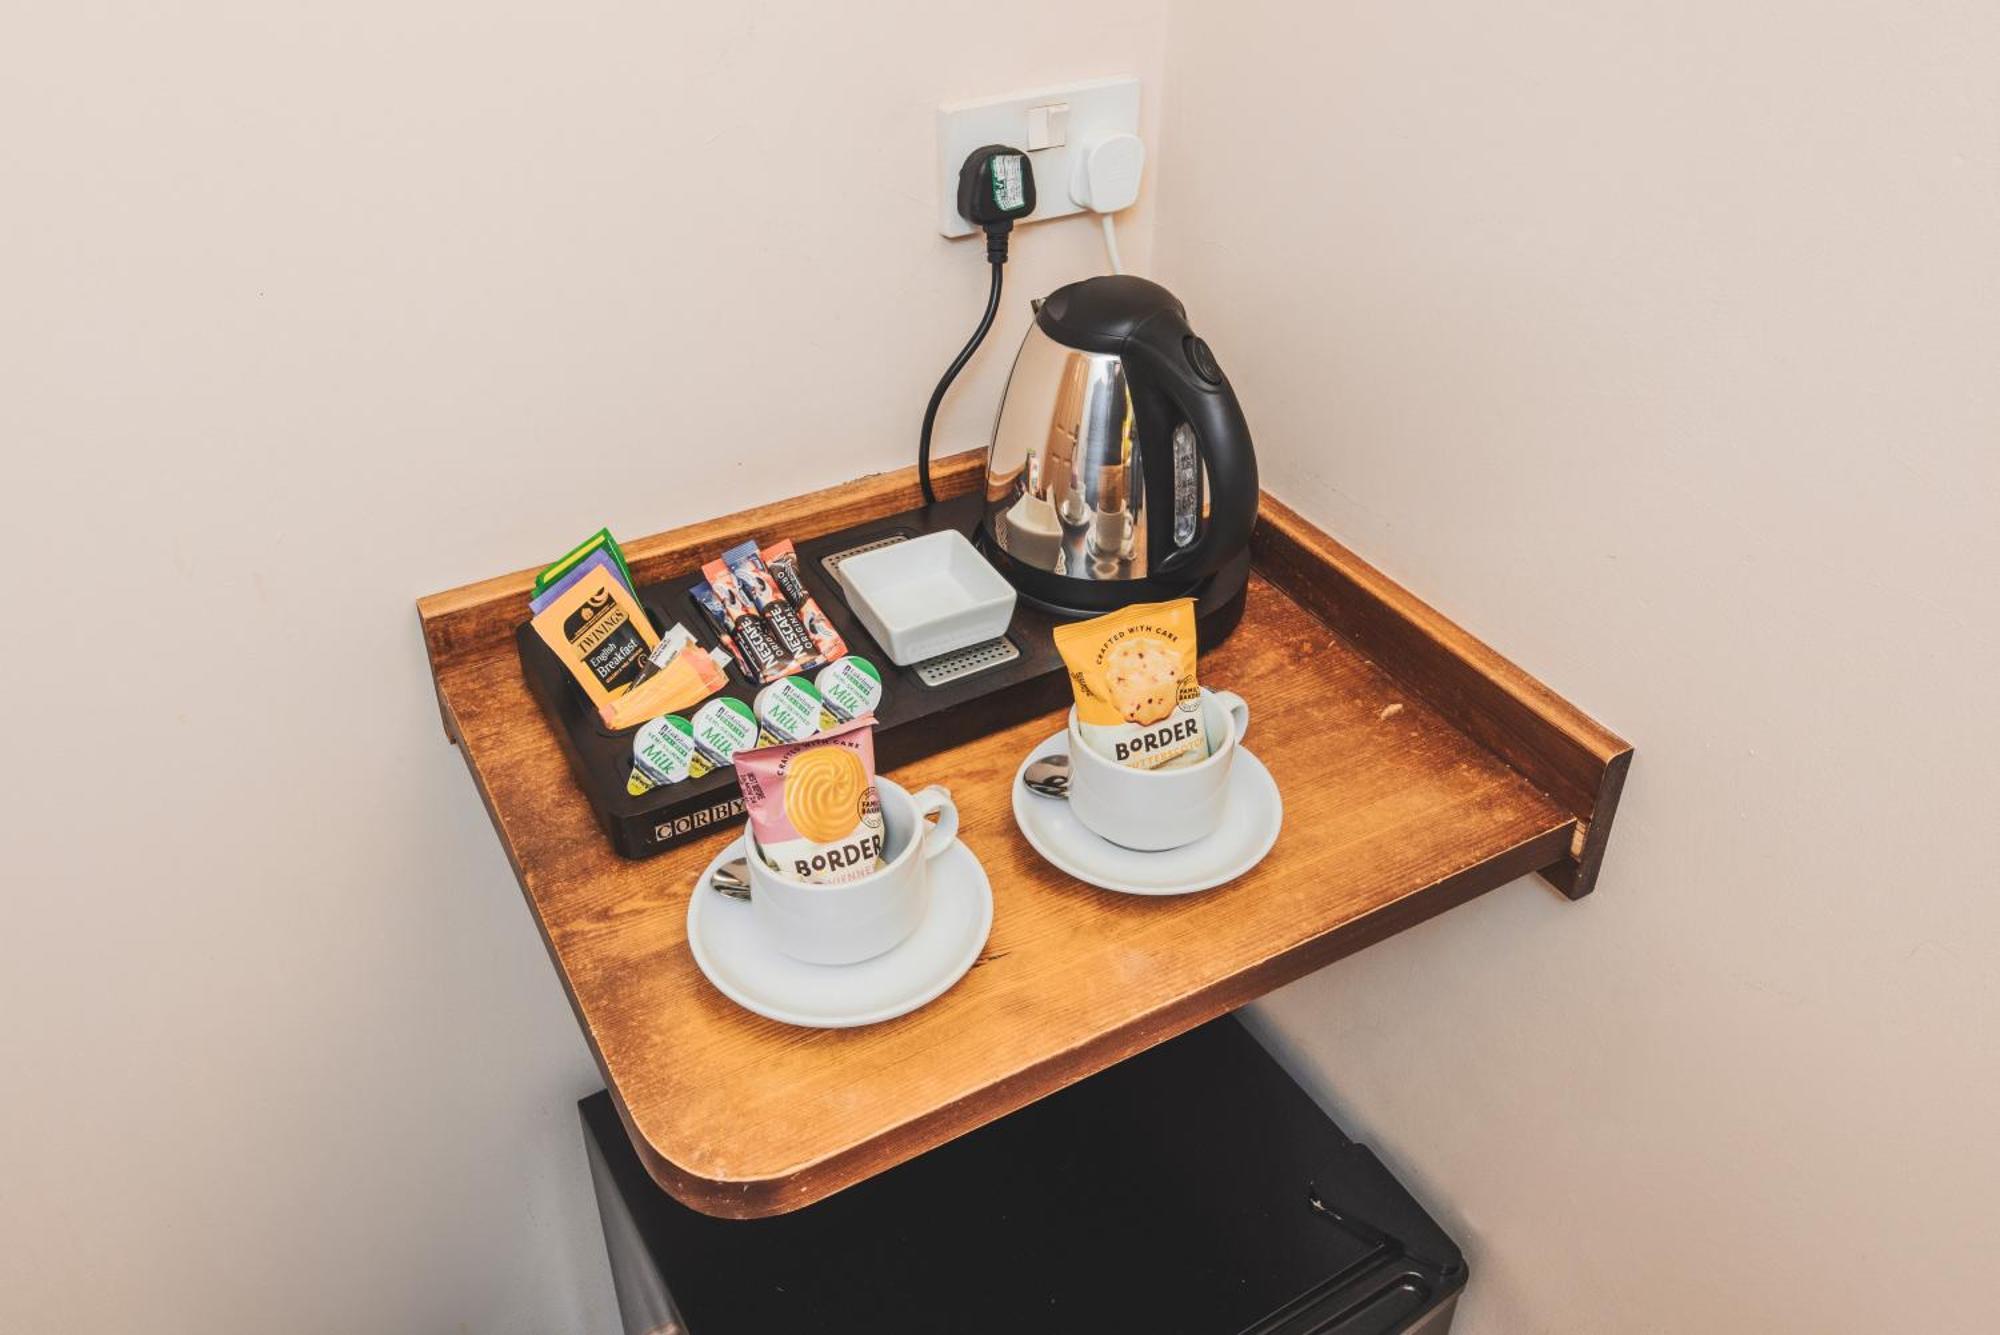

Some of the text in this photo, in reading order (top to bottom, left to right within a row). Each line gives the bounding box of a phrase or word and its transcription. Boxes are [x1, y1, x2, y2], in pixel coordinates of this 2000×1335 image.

[578, 608, 625, 653] TWININGS
[784, 603, 813, 649] ORIGINAL
[1096, 625, 1178, 665] CRAFTED WITH CARE
[590, 642, 617, 668] English
[597, 638, 638, 678] Breakfast
[768, 704, 798, 733] Milk
[828, 684, 859, 713] Milk
[642, 744, 675, 774] Milk
[701, 727, 733, 757] Milk
[1116, 718, 1198, 761] BORDER
[656, 799, 746, 840] CORBY
[794, 834, 881, 877] BORDER
